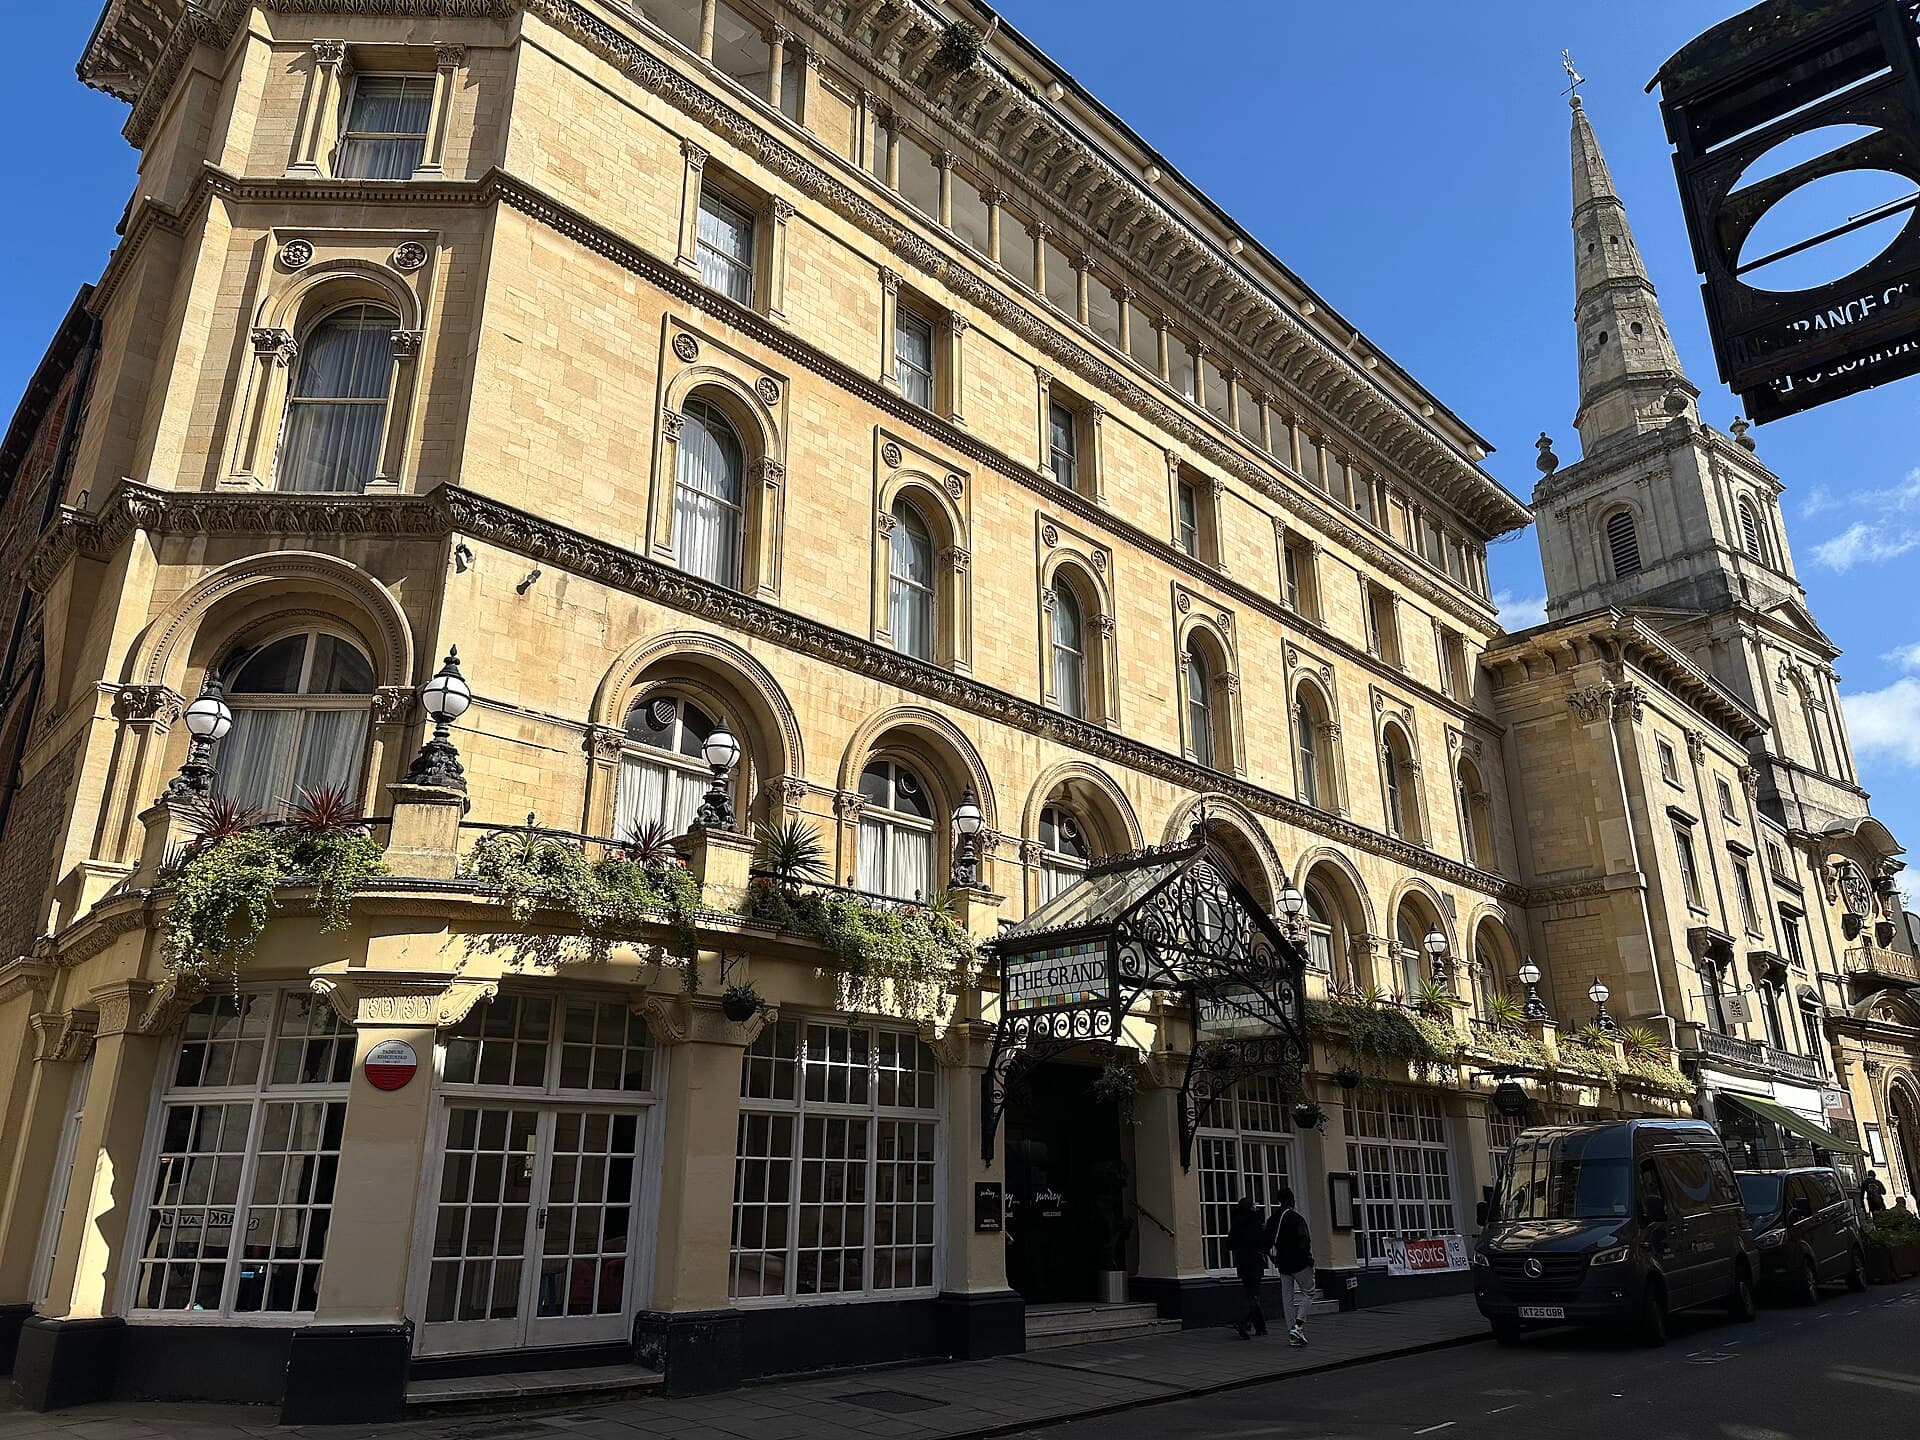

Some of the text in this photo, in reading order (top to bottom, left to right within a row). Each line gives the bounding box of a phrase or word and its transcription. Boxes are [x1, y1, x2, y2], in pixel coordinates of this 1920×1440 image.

[1009, 961, 1104, 997] THE GRAND
[1386, 1243, 1446, 1270] sky sports
[1450, 1254, 1468, 1267] here
